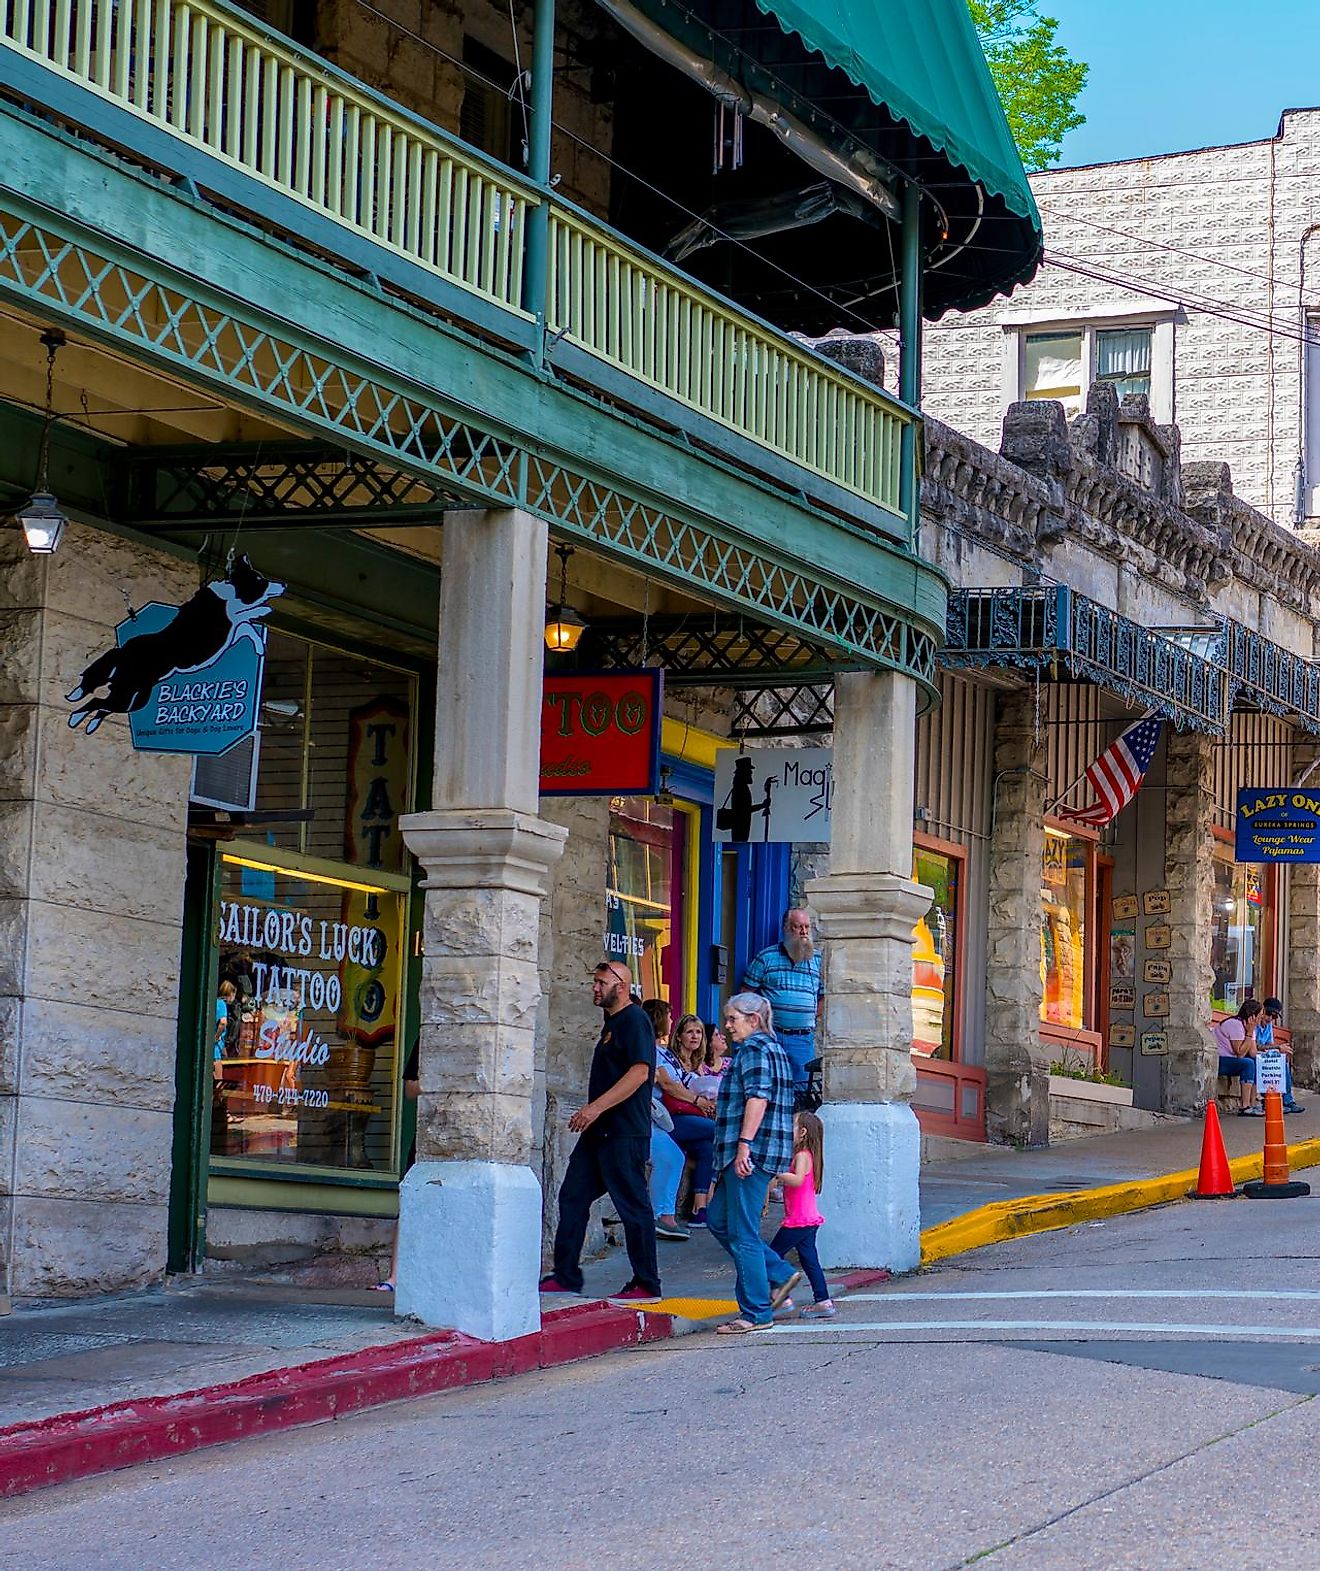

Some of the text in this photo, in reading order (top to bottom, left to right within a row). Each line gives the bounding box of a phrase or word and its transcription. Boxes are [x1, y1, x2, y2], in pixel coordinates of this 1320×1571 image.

[157, 680, 248, 703] BLACKIE'S
[155, 703, 246, 724] BACKYARD
[547, 691, 647, 737] TOO
[1241, 794, 1288, 818] LAZY
[1252, 834, 1286, 845] Lounge
[1262, 846, 1305, 857] Pajamas
[319, 920, 378, 967] LUCK
[252, 961, 341, 1013] TATTOO
[255, 1018, 331, 1066] Studio
